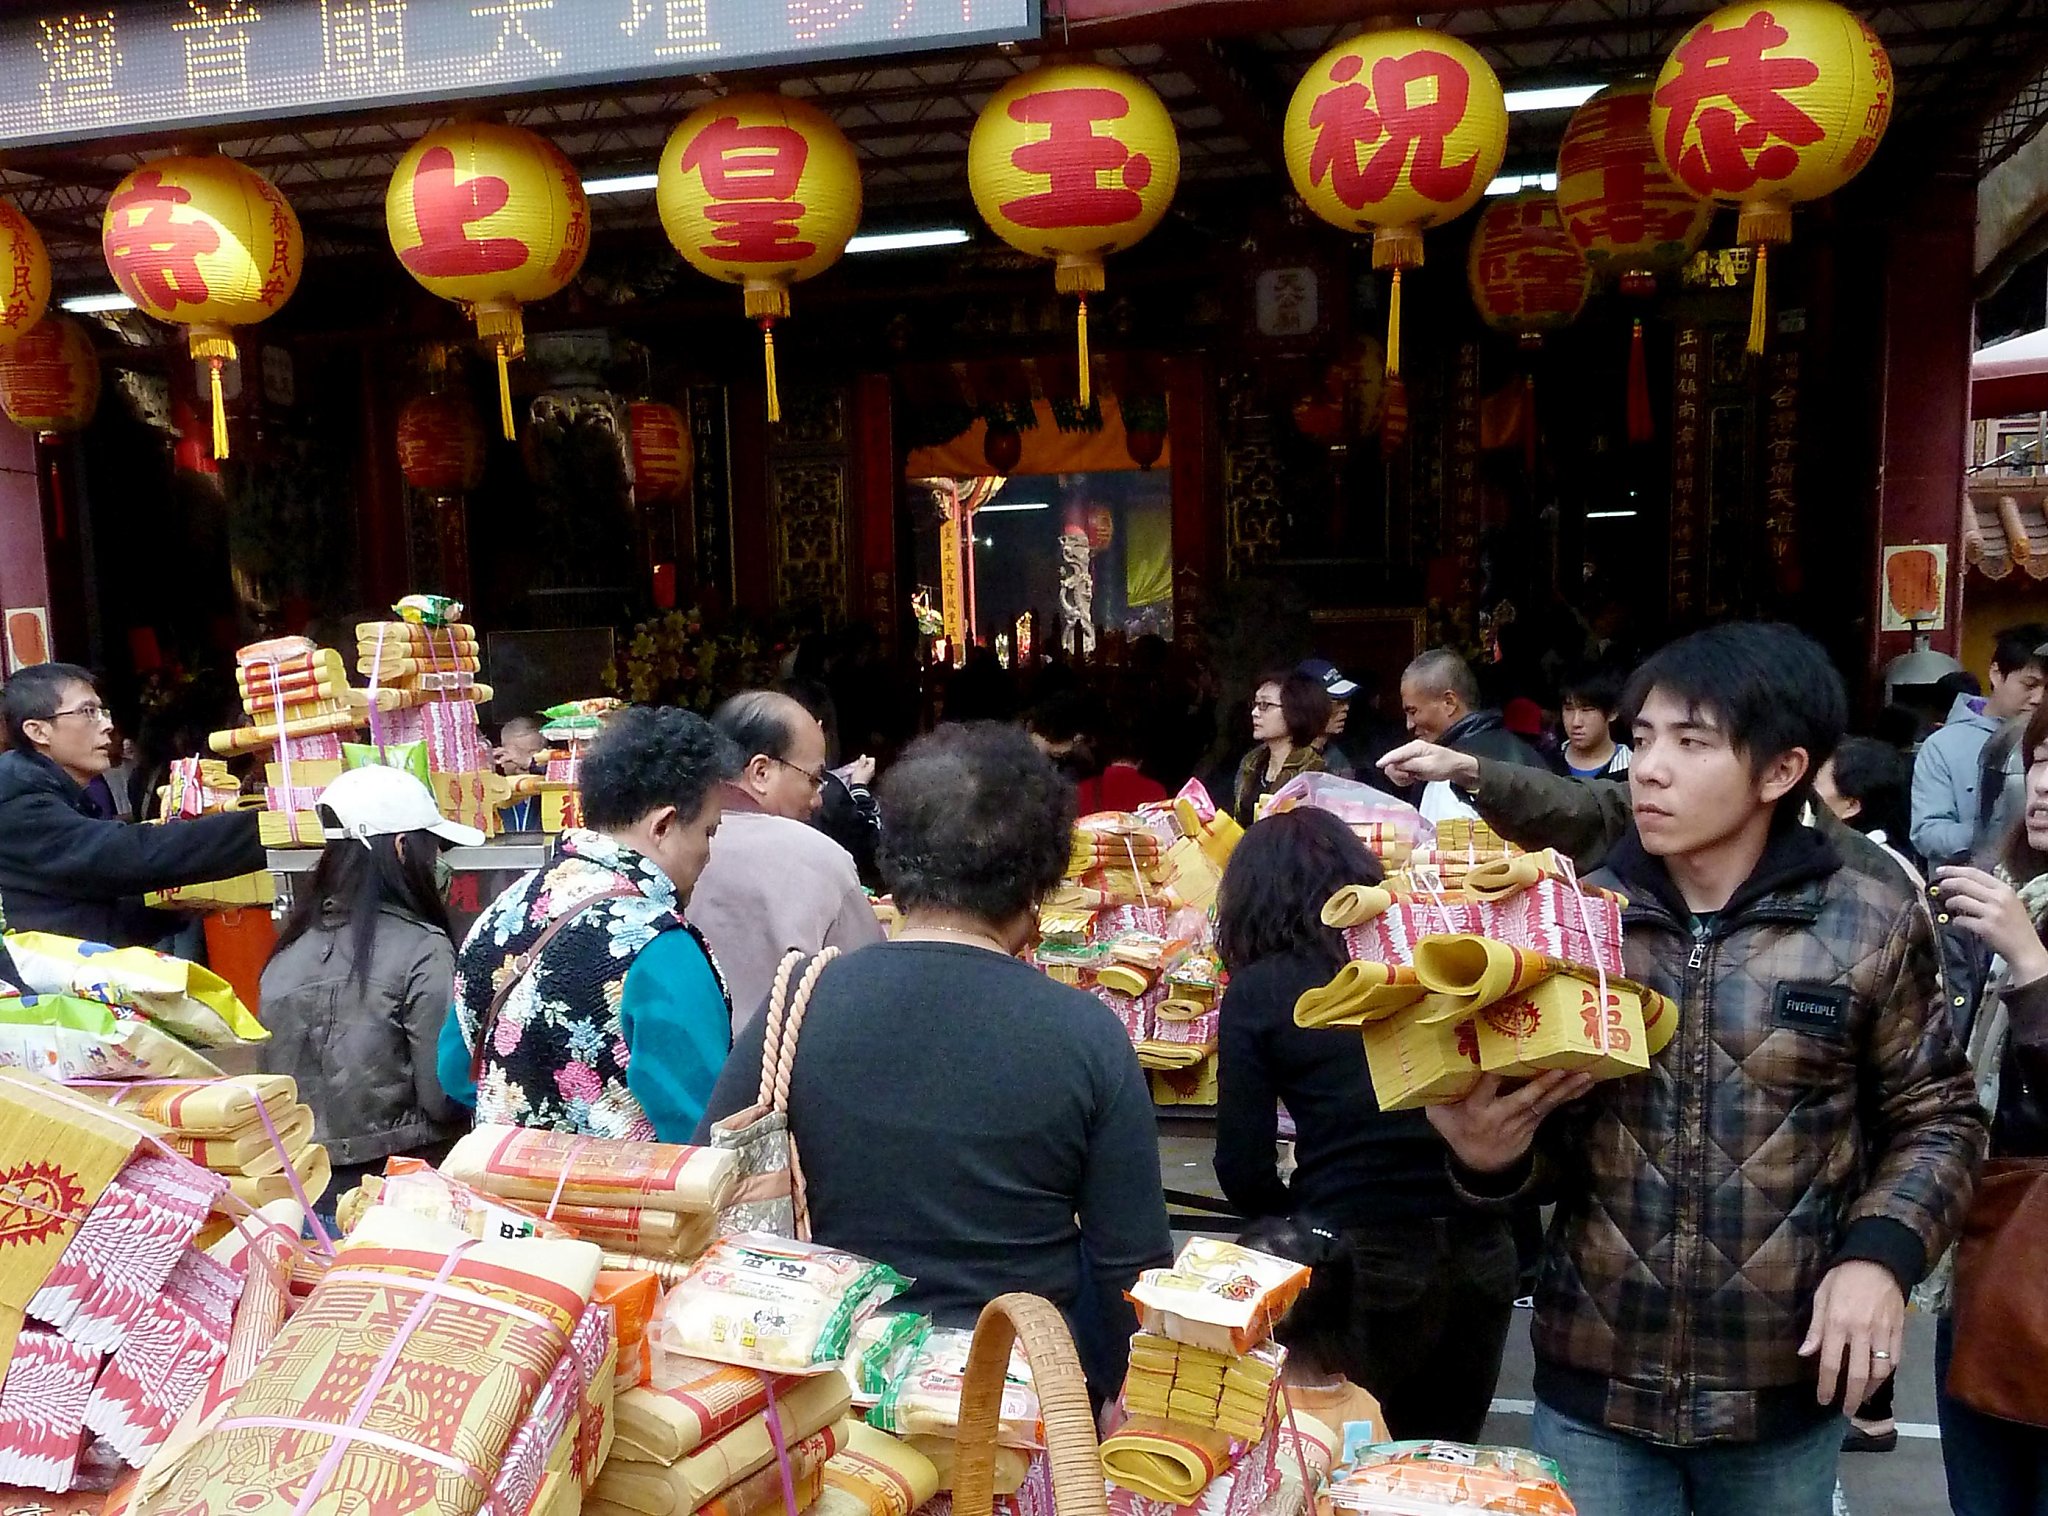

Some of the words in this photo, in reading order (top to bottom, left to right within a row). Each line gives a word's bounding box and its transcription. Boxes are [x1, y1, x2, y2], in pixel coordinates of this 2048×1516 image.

[999, 87, 1152, 229] 玉
[1309, 50, 1482, 210] 祝
[1653, 10, 1827, 197] 恭
[105, 170, 221, 312] 帝
[399, 146, 530, 278] 上
[681, 116, 817, 263] 皇
[1580, 989, 1632, 1053] 福
